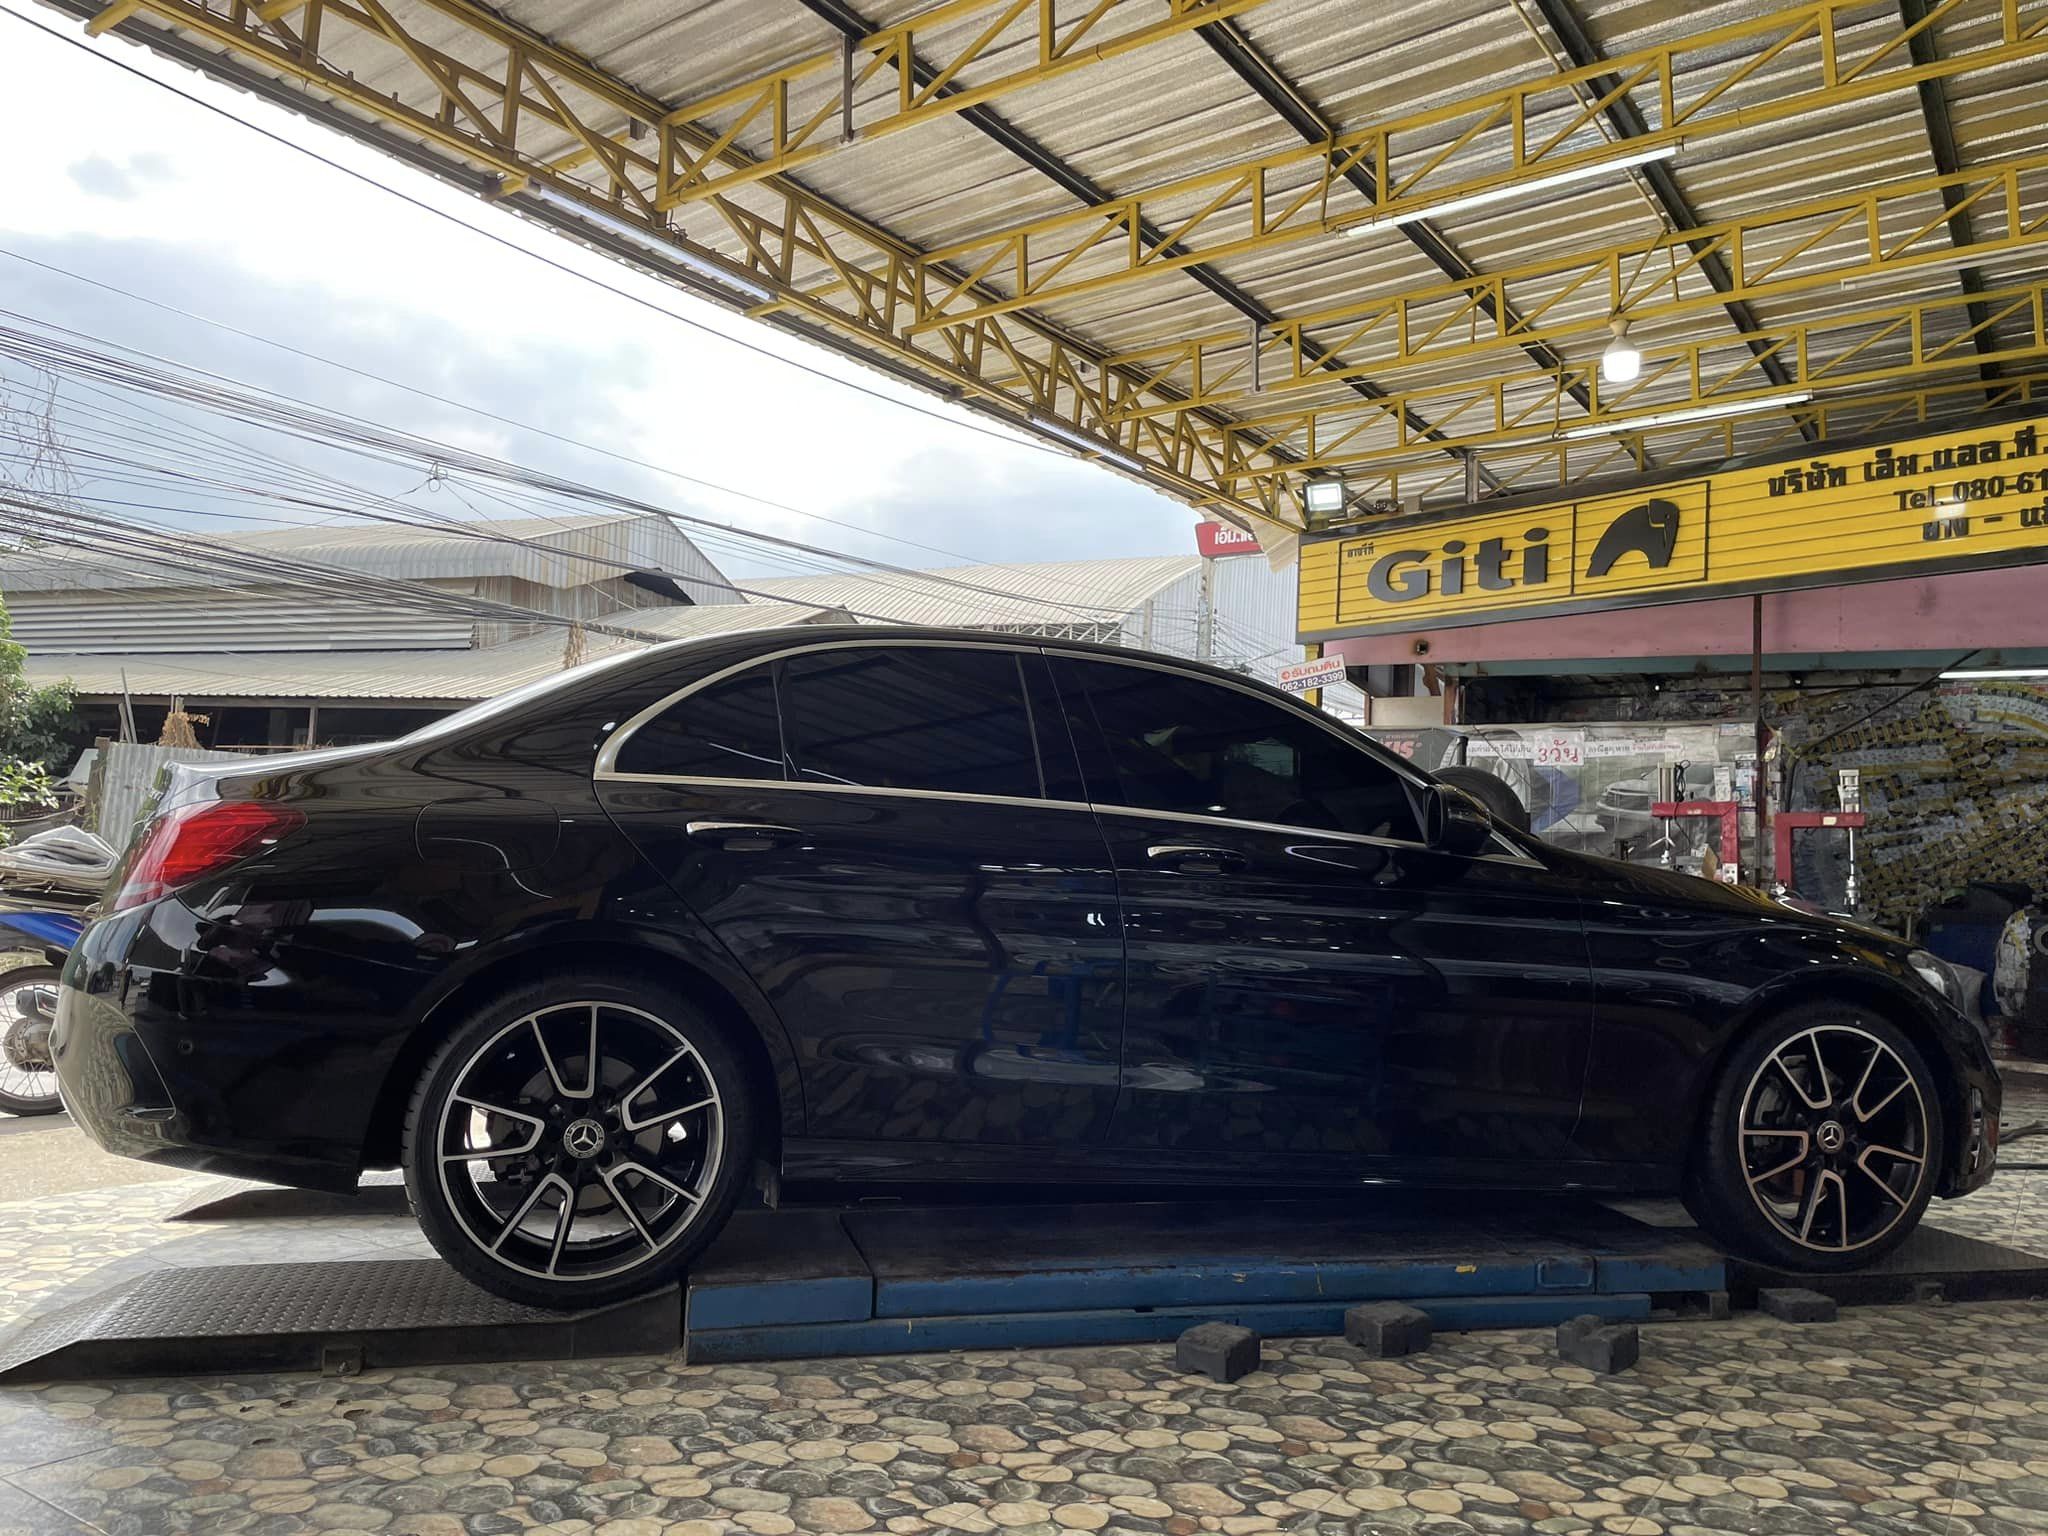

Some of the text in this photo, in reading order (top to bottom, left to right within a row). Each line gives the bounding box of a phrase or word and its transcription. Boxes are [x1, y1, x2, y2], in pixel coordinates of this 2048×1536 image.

[1768, 461, 1847, 497] บริษัท
[1894, 485, 1945, 511] Tel.
[1366, 527, 1550, 603] Giti
[1281, 671, 1344, 692] 062-182-3399
